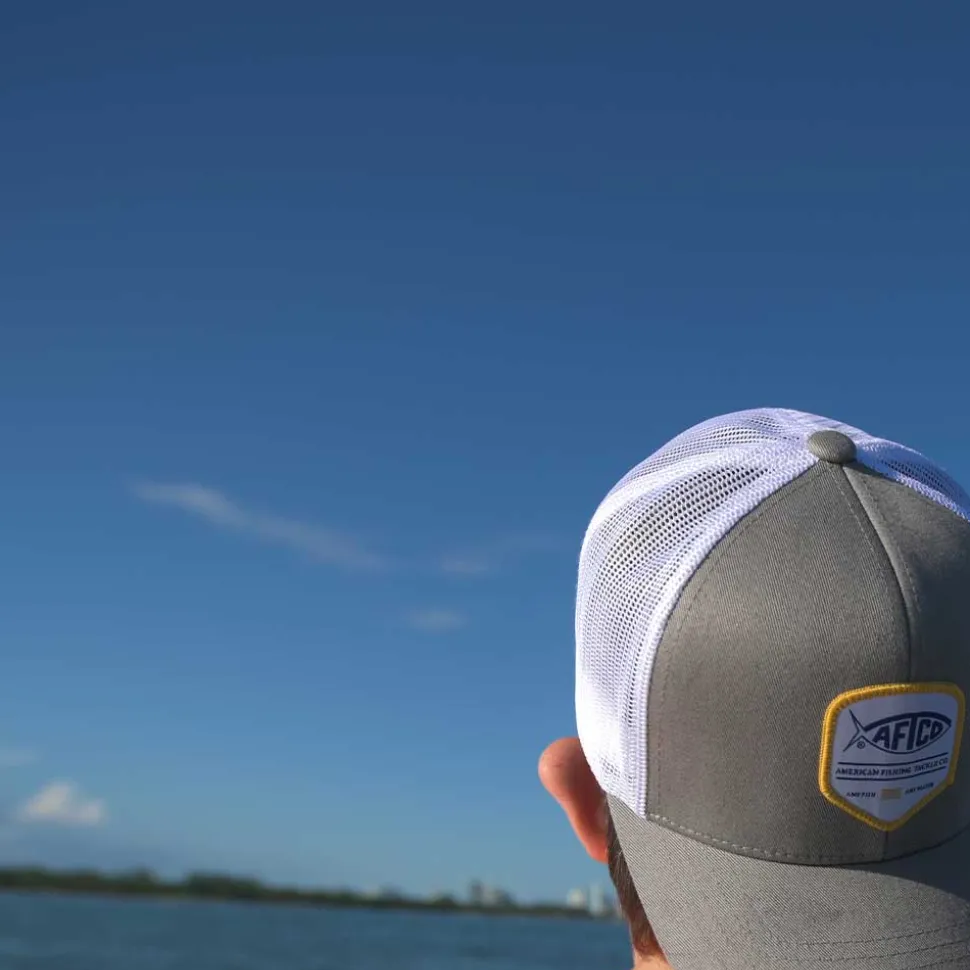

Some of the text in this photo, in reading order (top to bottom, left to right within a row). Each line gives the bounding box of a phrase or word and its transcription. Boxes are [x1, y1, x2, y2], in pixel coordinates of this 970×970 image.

[872, 712, 944, 751] AFTCO
[835, 766, 879, 777] AMERICAN
[880, 766, 912, 777] FISHING
